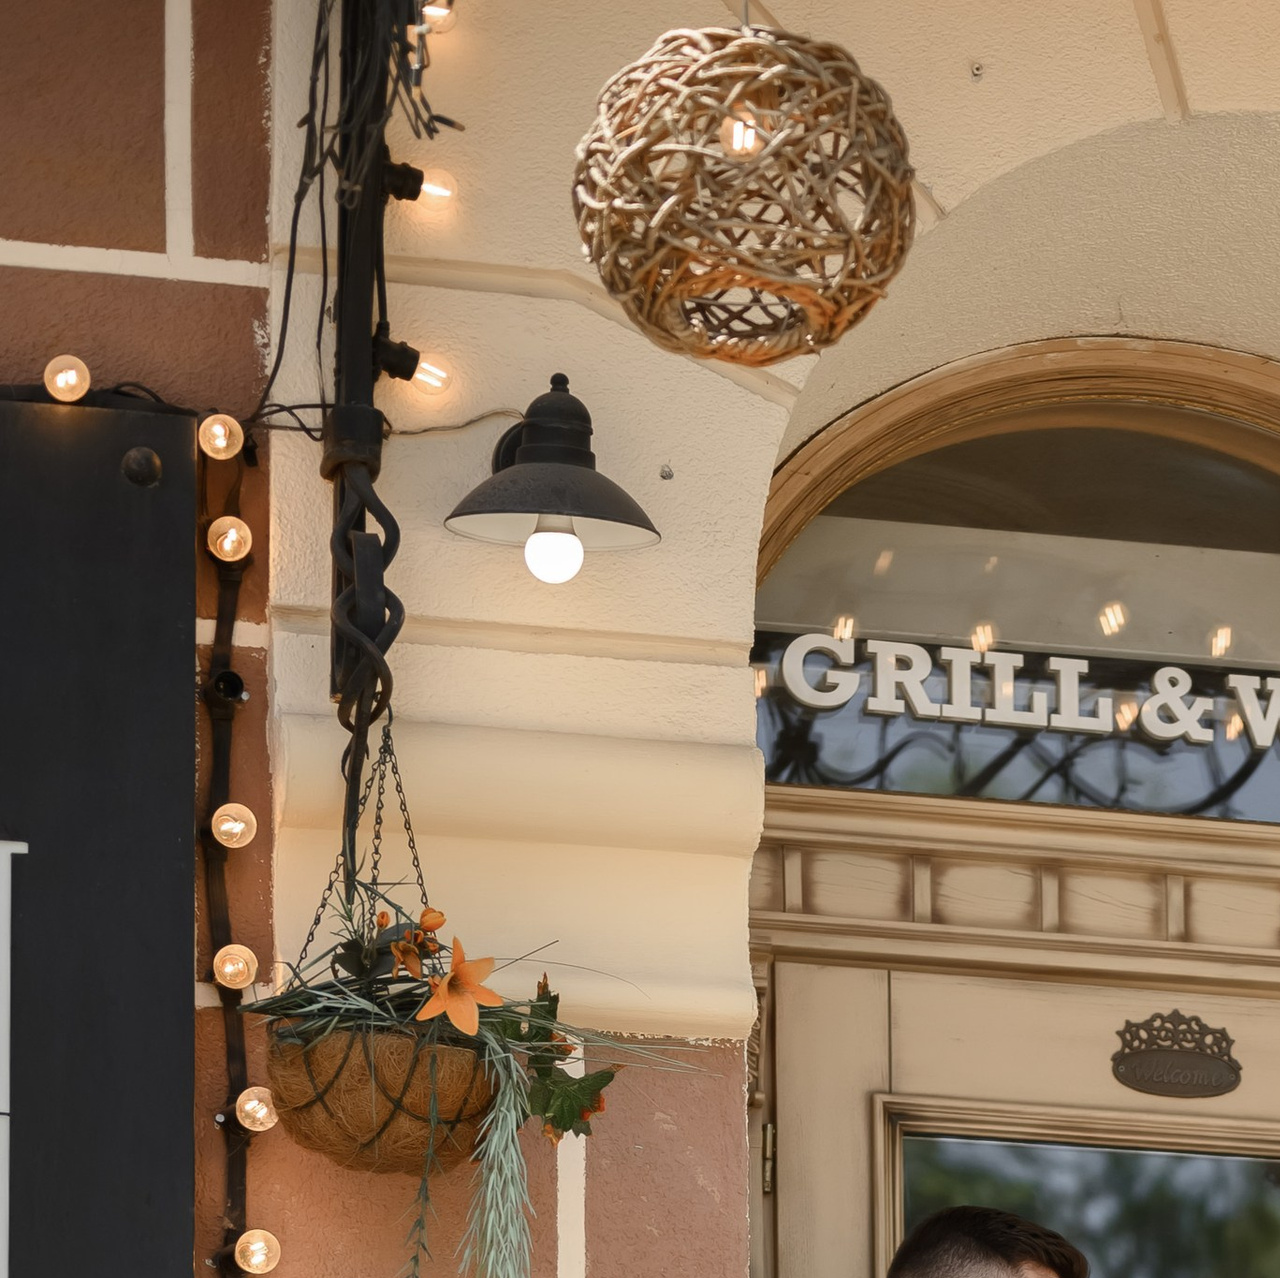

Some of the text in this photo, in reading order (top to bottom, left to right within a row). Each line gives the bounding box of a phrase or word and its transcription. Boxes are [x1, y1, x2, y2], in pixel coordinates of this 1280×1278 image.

[782, 633, 1114, 735] GRILL
[1141, 667, 1214, 744] &
[1132, 1059, 1223, 1086] Welcome
